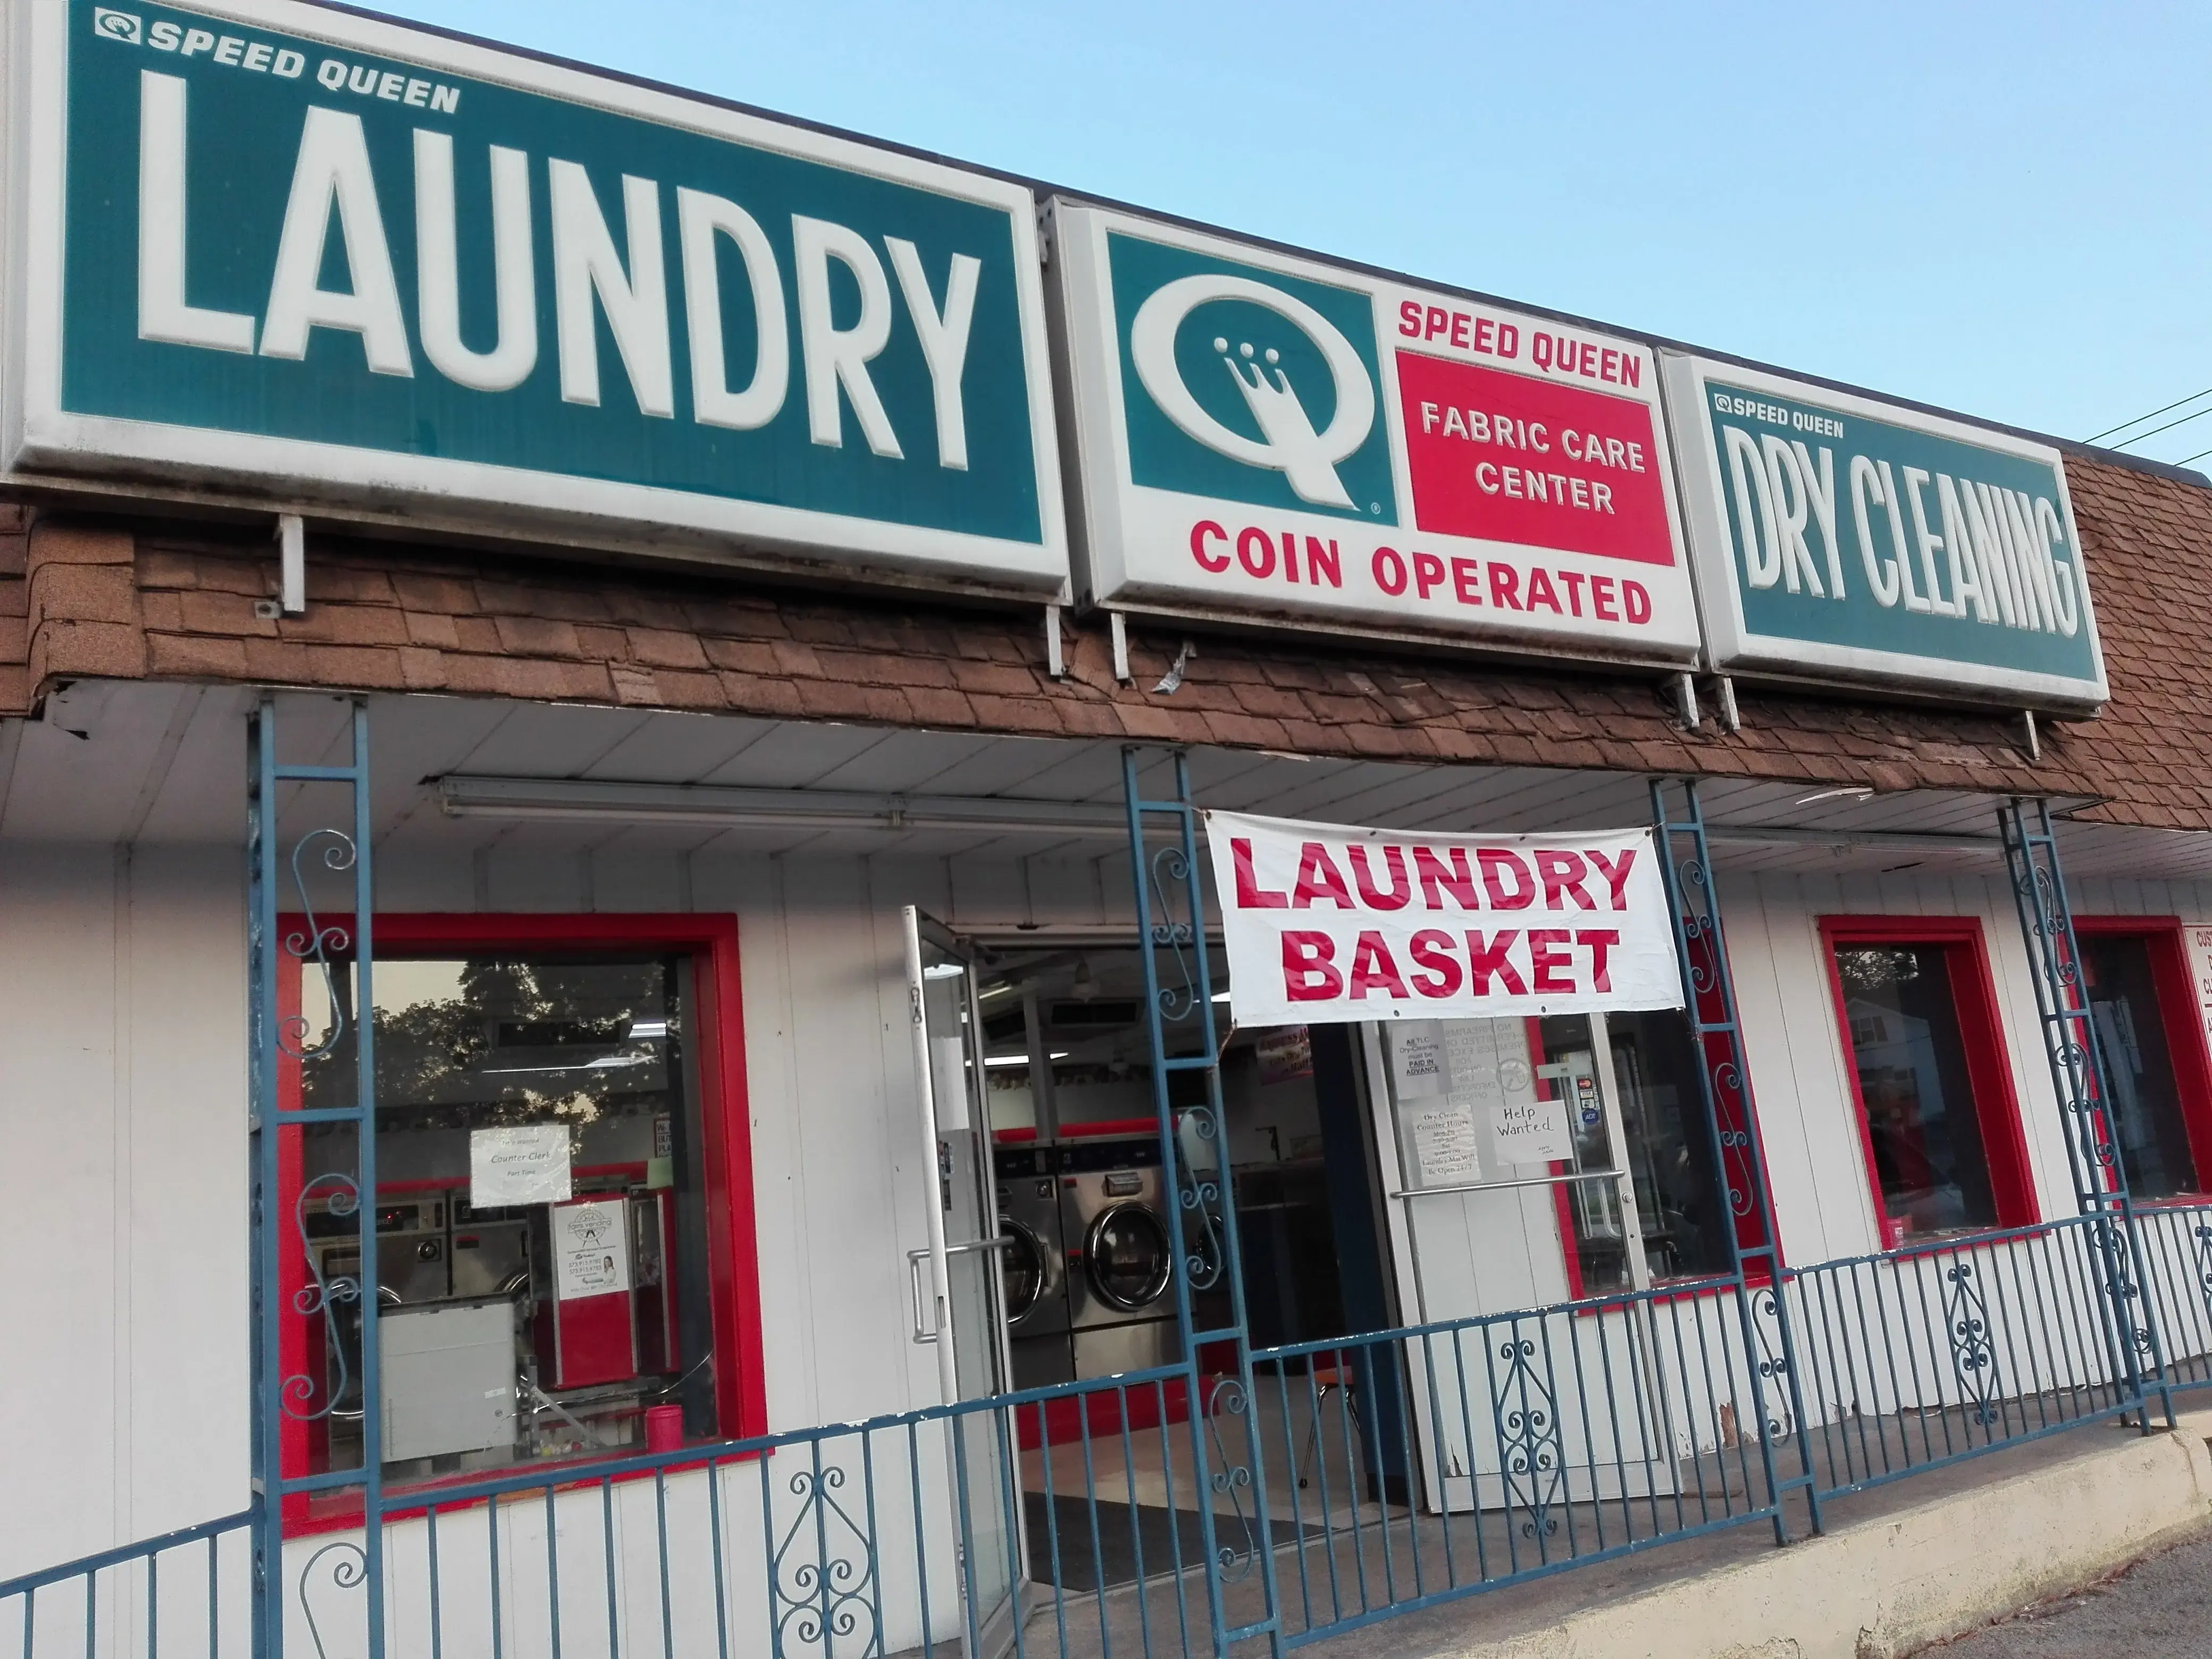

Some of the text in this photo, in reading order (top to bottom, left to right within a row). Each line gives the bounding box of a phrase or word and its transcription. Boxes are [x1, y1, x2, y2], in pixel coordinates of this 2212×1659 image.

[148, 22, 305, 79] SPEED
[317, 59, 460, 113] QUEEN
[138, 70, 981, 471] LAUNDRY
[1397, 300, 1641, 389] SPEED QUEEN
[1420, 400, 1646, 473] FABRIC CARE
[1734, 398, 1788, 426] SPEED
[1793, 412, 1844, 439] QUEEN
[1474, 461, 1615, 515] CENTER
[1723, 425, 2077, 638] DRY CLEANING
[1189, 519, 1652, 626] COIN OPERATED
[1229, 837, 1637, 911] LAUNDRY
[1280, 929, 1621, 1003] BASKET
[1406, 1066, 1439, 1076] ADVANCE
[1496, 1116, 1554, 1136] Wanted
[1504, 1106, 1535, 1120] Help
[491, 1151, 551, 1163] Counter Clerk
[585, 1220, 611, 1228] vending
